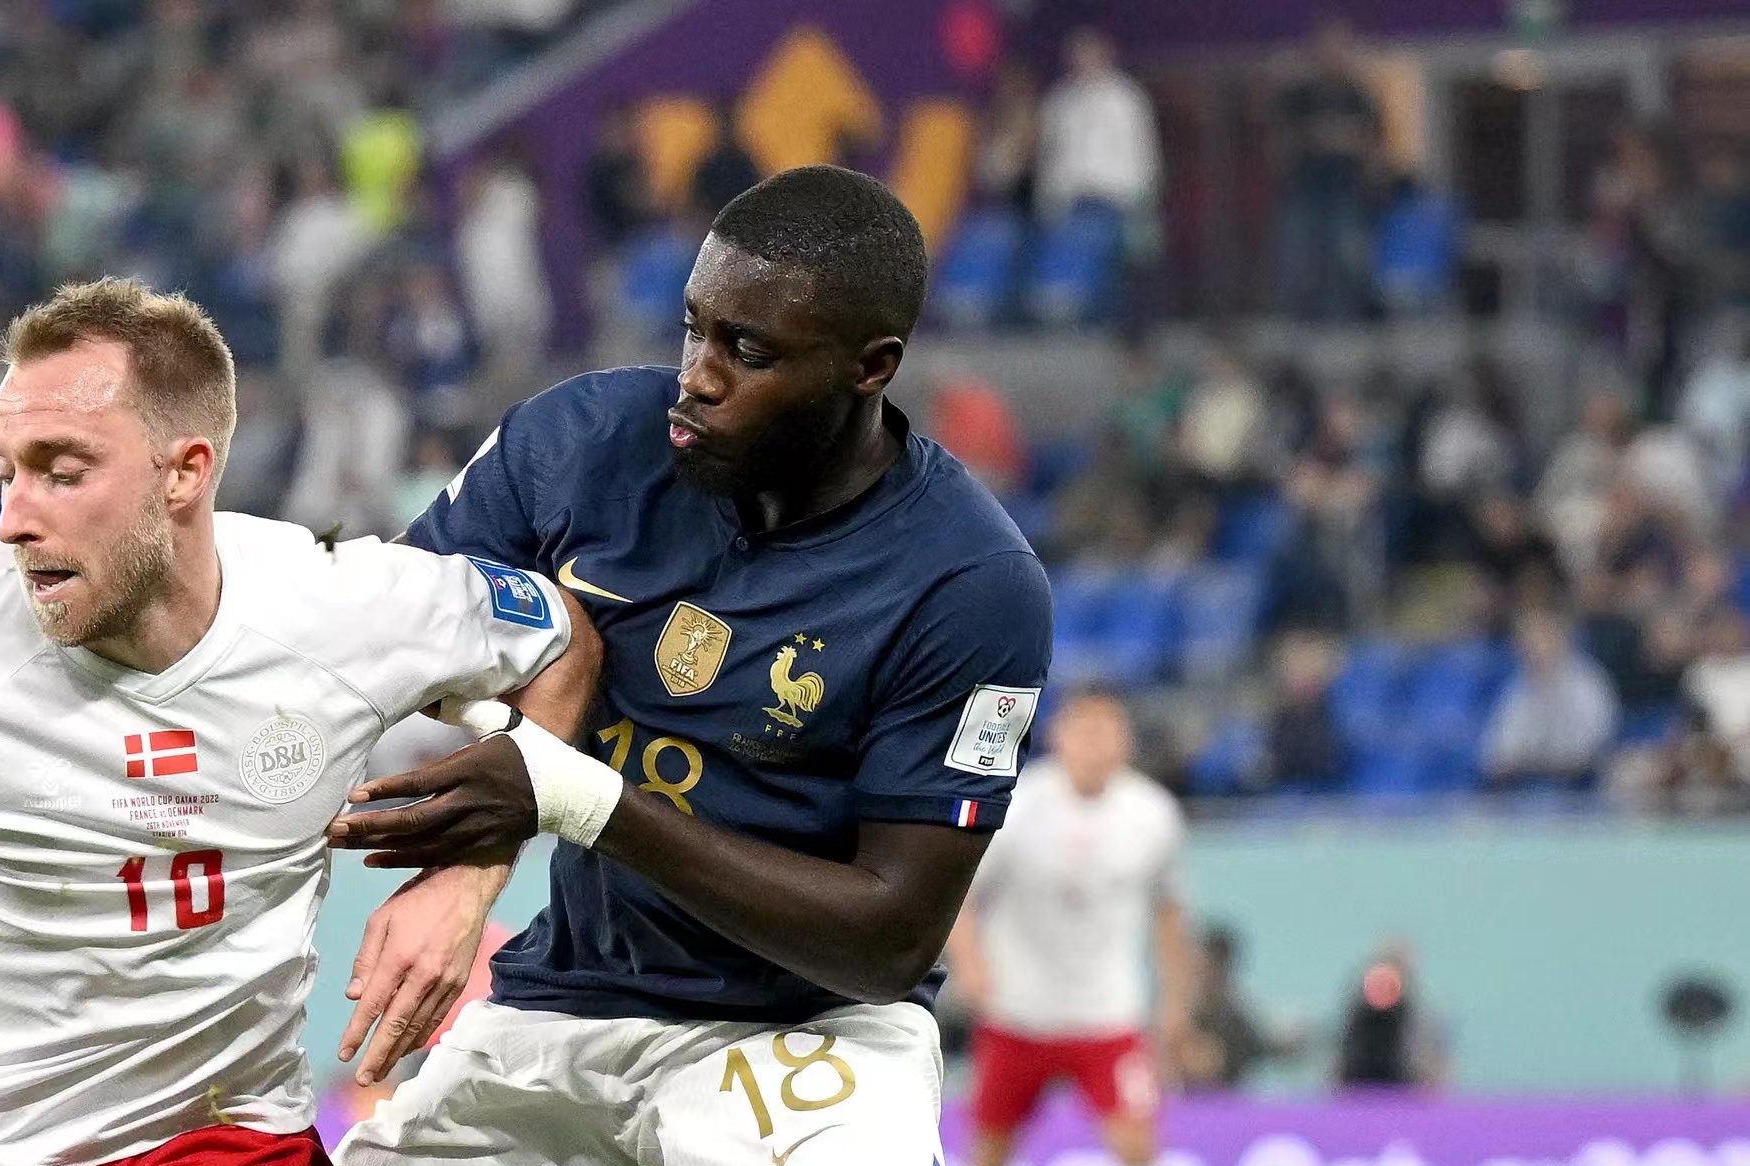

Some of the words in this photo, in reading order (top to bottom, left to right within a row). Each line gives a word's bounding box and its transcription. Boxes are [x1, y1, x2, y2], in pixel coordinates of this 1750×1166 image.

[669, 658, 696, 681] FIFA
[258, 741, 308, 773] DBU
[112, 798, 128, 809] FIFA
[130, 796, 155, 808] WORLD
[158, 795, 172, 805] CUP
[175, 795, 198, 805] QATAR
[200, 794, 219, 804] 2022
[130, 808, 158, 821] FRANCE
[167, 805, 204, 818] DENMARK
[162, 818, 190, 829] NOVEMBER
[116, 849, 225, 931] 10
[719, 1027, 856, 1140] 18
